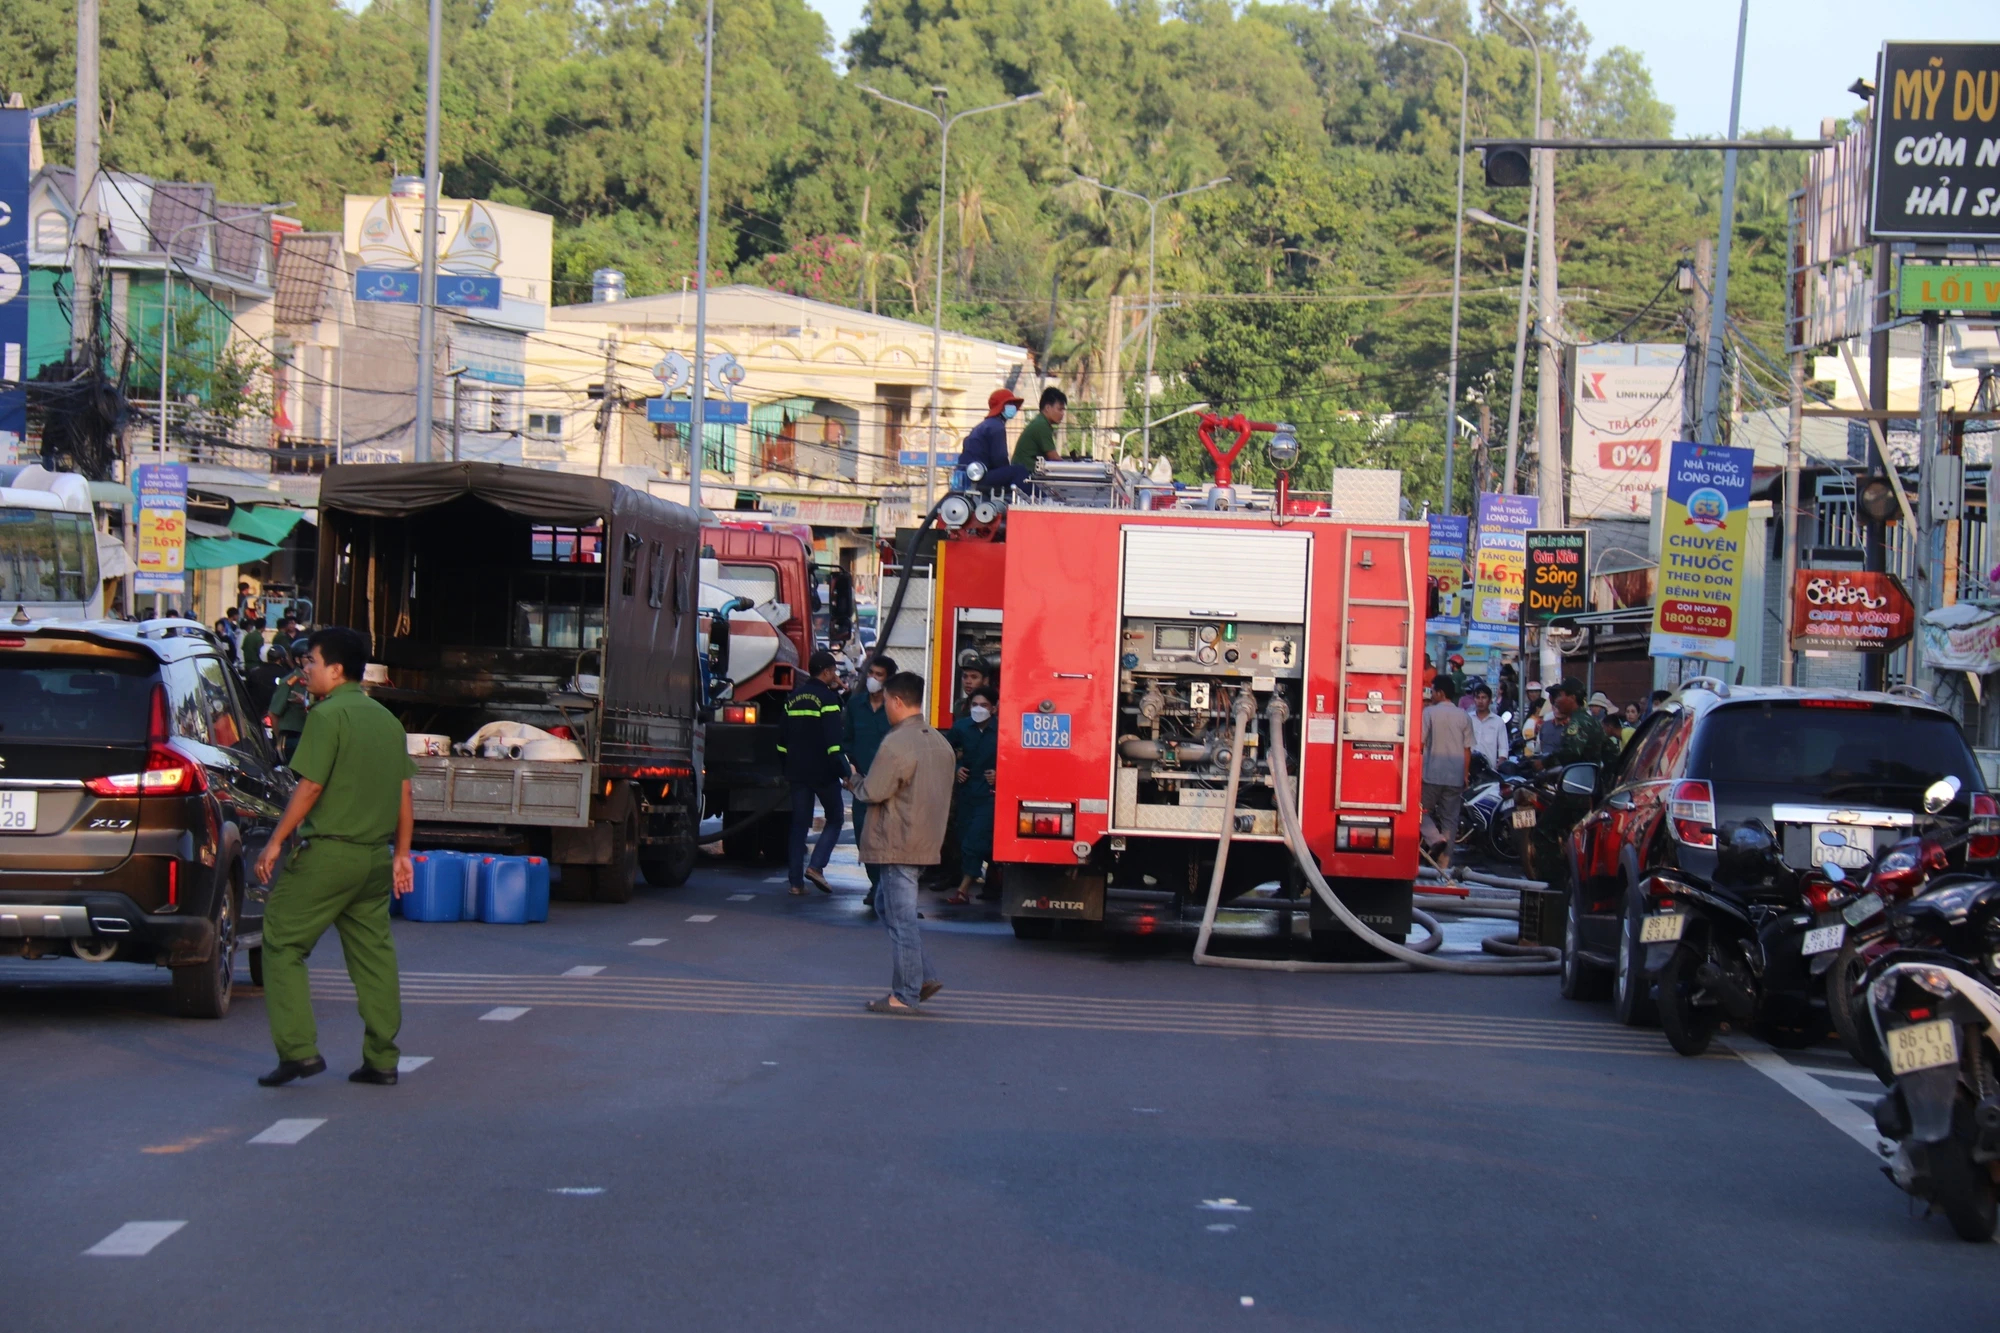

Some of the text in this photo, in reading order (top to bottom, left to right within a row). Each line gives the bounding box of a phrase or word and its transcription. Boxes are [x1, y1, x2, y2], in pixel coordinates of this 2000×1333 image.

[1893, 56, 2000, 122] MỸ DU
[1894, 131, 1967, 167] CƠM
[1904, 175, 1967, 215] HẢI
[1921, 273, 1973, 303] LỐI
[1616, 391, 1673, 400] LINH KHANG
[1608, 416, 1630, 429] TRẢ
[1612, 445, 1651, 467] 0%
[1684, 458, 1739, 473] NHÀ THUỐC
[1677, 470, 1745, 488] LONG CHÂU
[1490, 505, 1504, 513] NHÀ
[1694, 499, 1720, 517] 63
[1486, 513, 1532, 525] LONG CHÂU
[1480, 525, 1501, 533] 1600
[153, 537, 169, 547] 1.6
[1669, 535, 1737, 552] CHUYÊN
[1533, 549, 1555, 564] Cơm
[1669, 553, 1734, 572] THUỐC
[1478, 562, 1508, 582] 1.6
[1535, 565, 1578, 589] Sông
[1667, 570, 1733, 587] THEO ĐƠN
[1529, 589, 1582, 613] Duyên
[1665, 585, 1732, 602] BỆNH VIỆN
[1677, 603, 1718, 614] GỌI NGAY
[1808, 609, 1853, 622] CAFE
[1665, 612, 1727, 628] 1800 6928
[1805, 622, 1840, 635] SÂN
[1033, 715, 1059, 731] 86A
[1023, 731, 1069, 747] 003.28
[90, 818, 132, 829] XL7
[1899, 1025, 1943, 1049] 86-C1
[1896, 1043, 1953, 1070] 402.38
